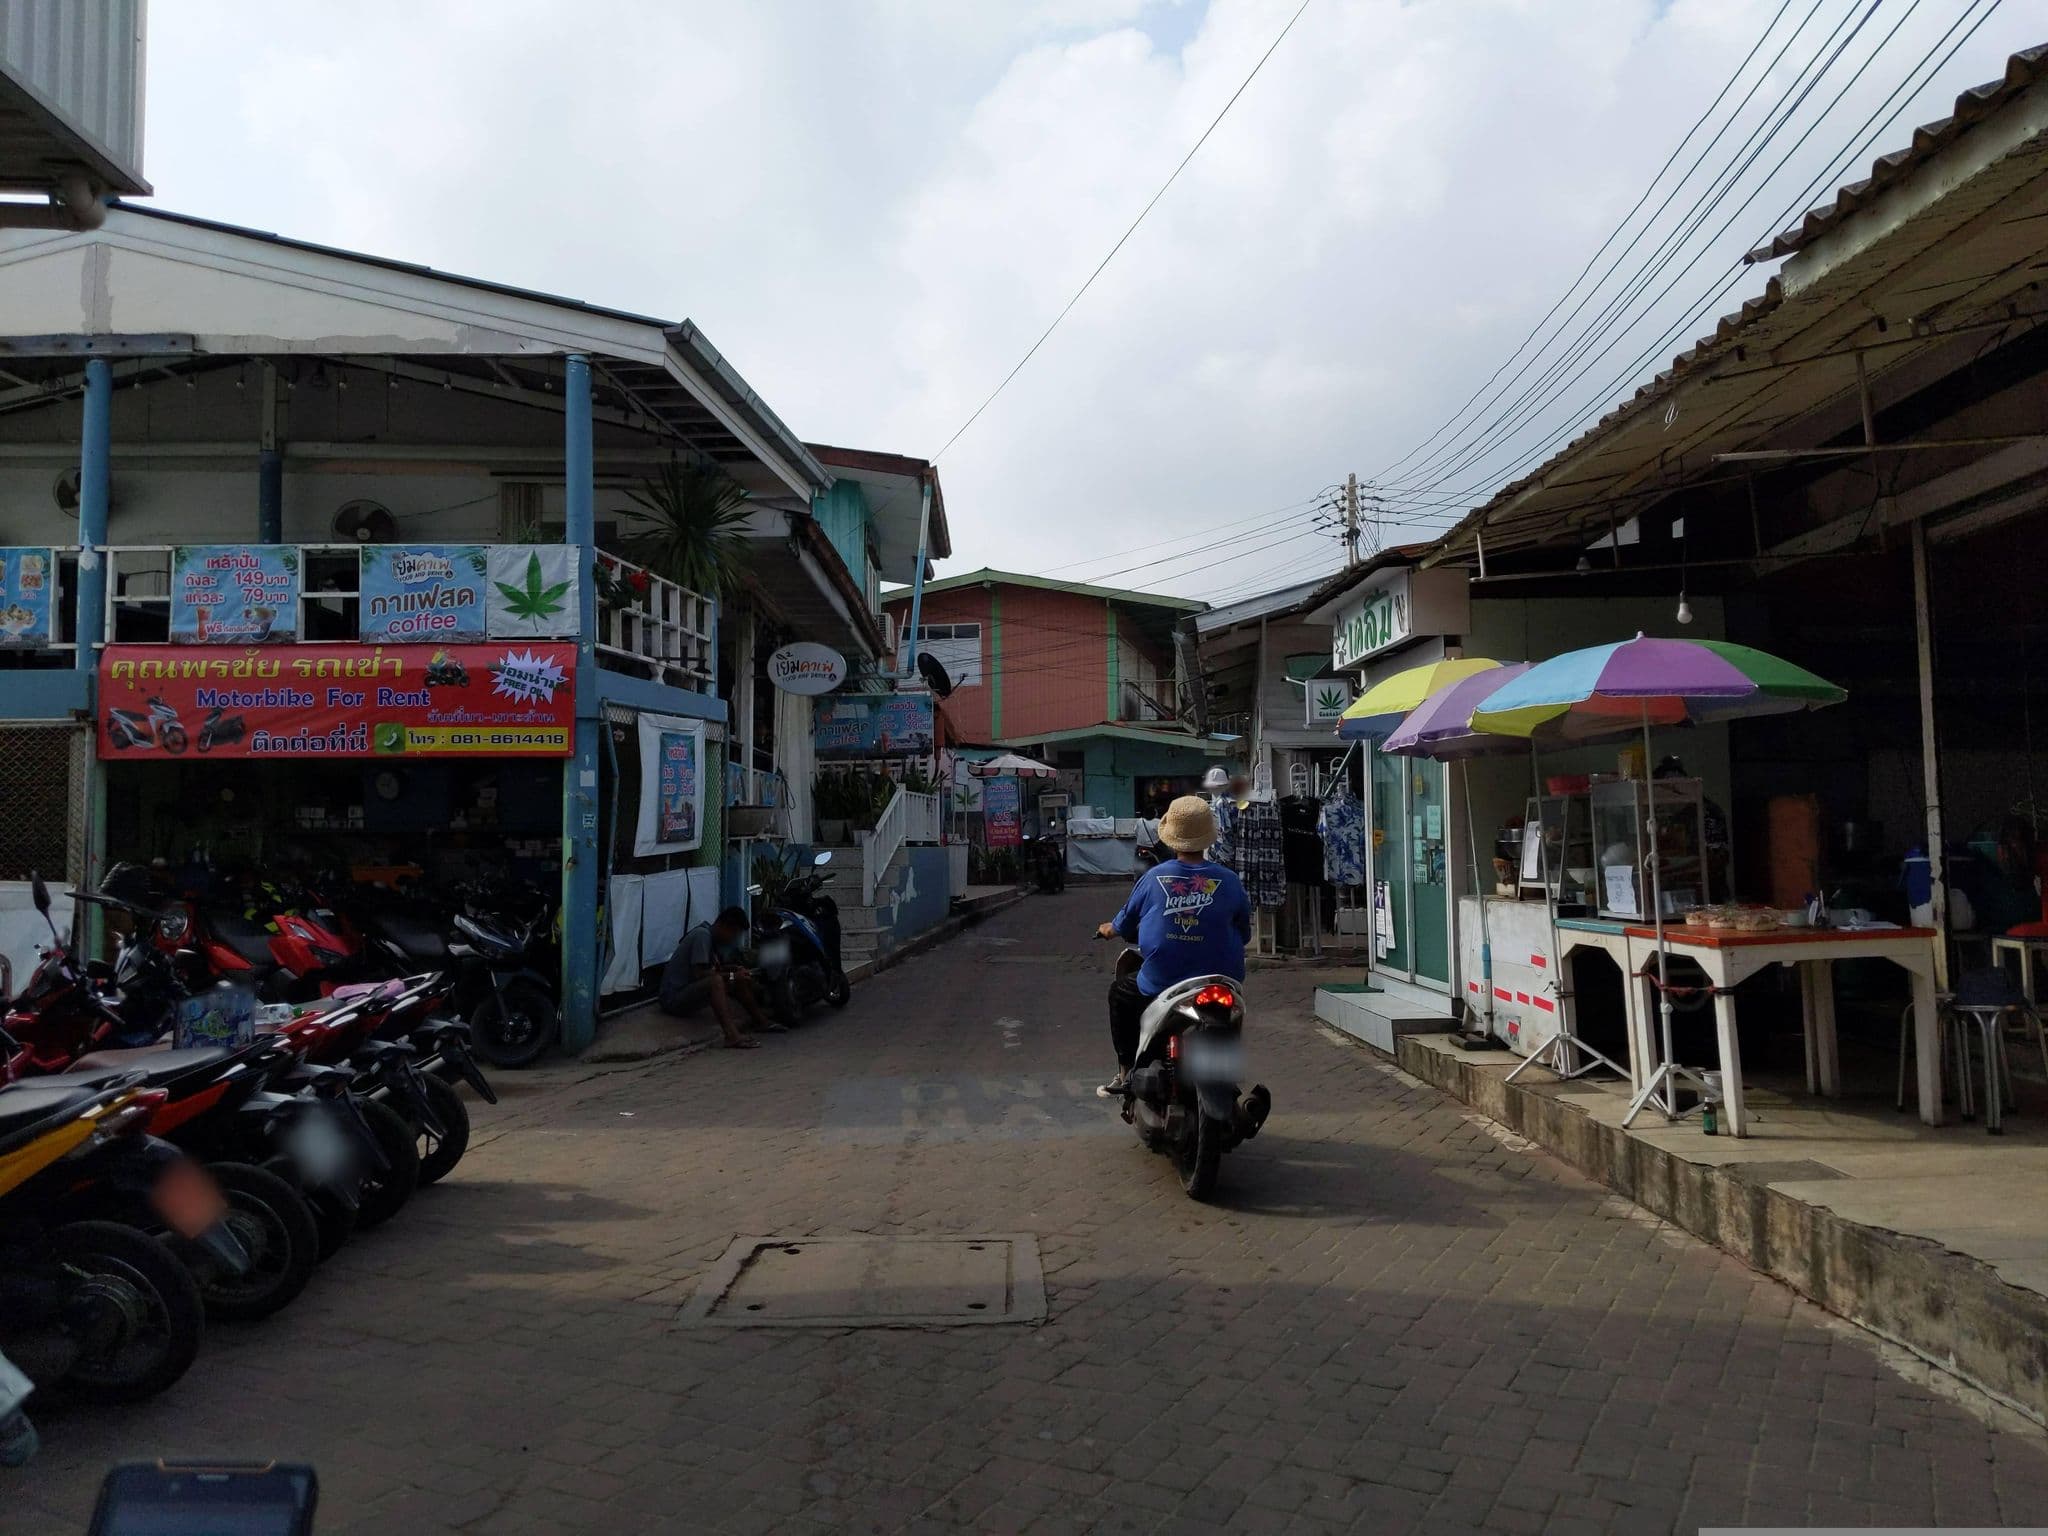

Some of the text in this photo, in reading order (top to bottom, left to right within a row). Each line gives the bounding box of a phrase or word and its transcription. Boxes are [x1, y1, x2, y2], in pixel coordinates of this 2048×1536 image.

[206, 549, 259, 569] เหล้าปั่น
[235, 571, 264, 585] 149
[265, 576, 288, 585] บาท
[243, 588, 264, 603] 79
[265, 593, 288, 602] บาท
[371, 584, 474, 615] กาแฟสด
[388, 613, 457, 634] coffee
[111, 647, 404, 690] คุณพรชัย รถเช่า
[503, 678, 528, 691] FREE
[196, 687, 431, 708] Motorbike For Rent
[252, 723, 369, 752] ติดต่อที่นี่
[408, 731, 435, 745] โทร
[451, 733, 564, 745] 081-8614418
